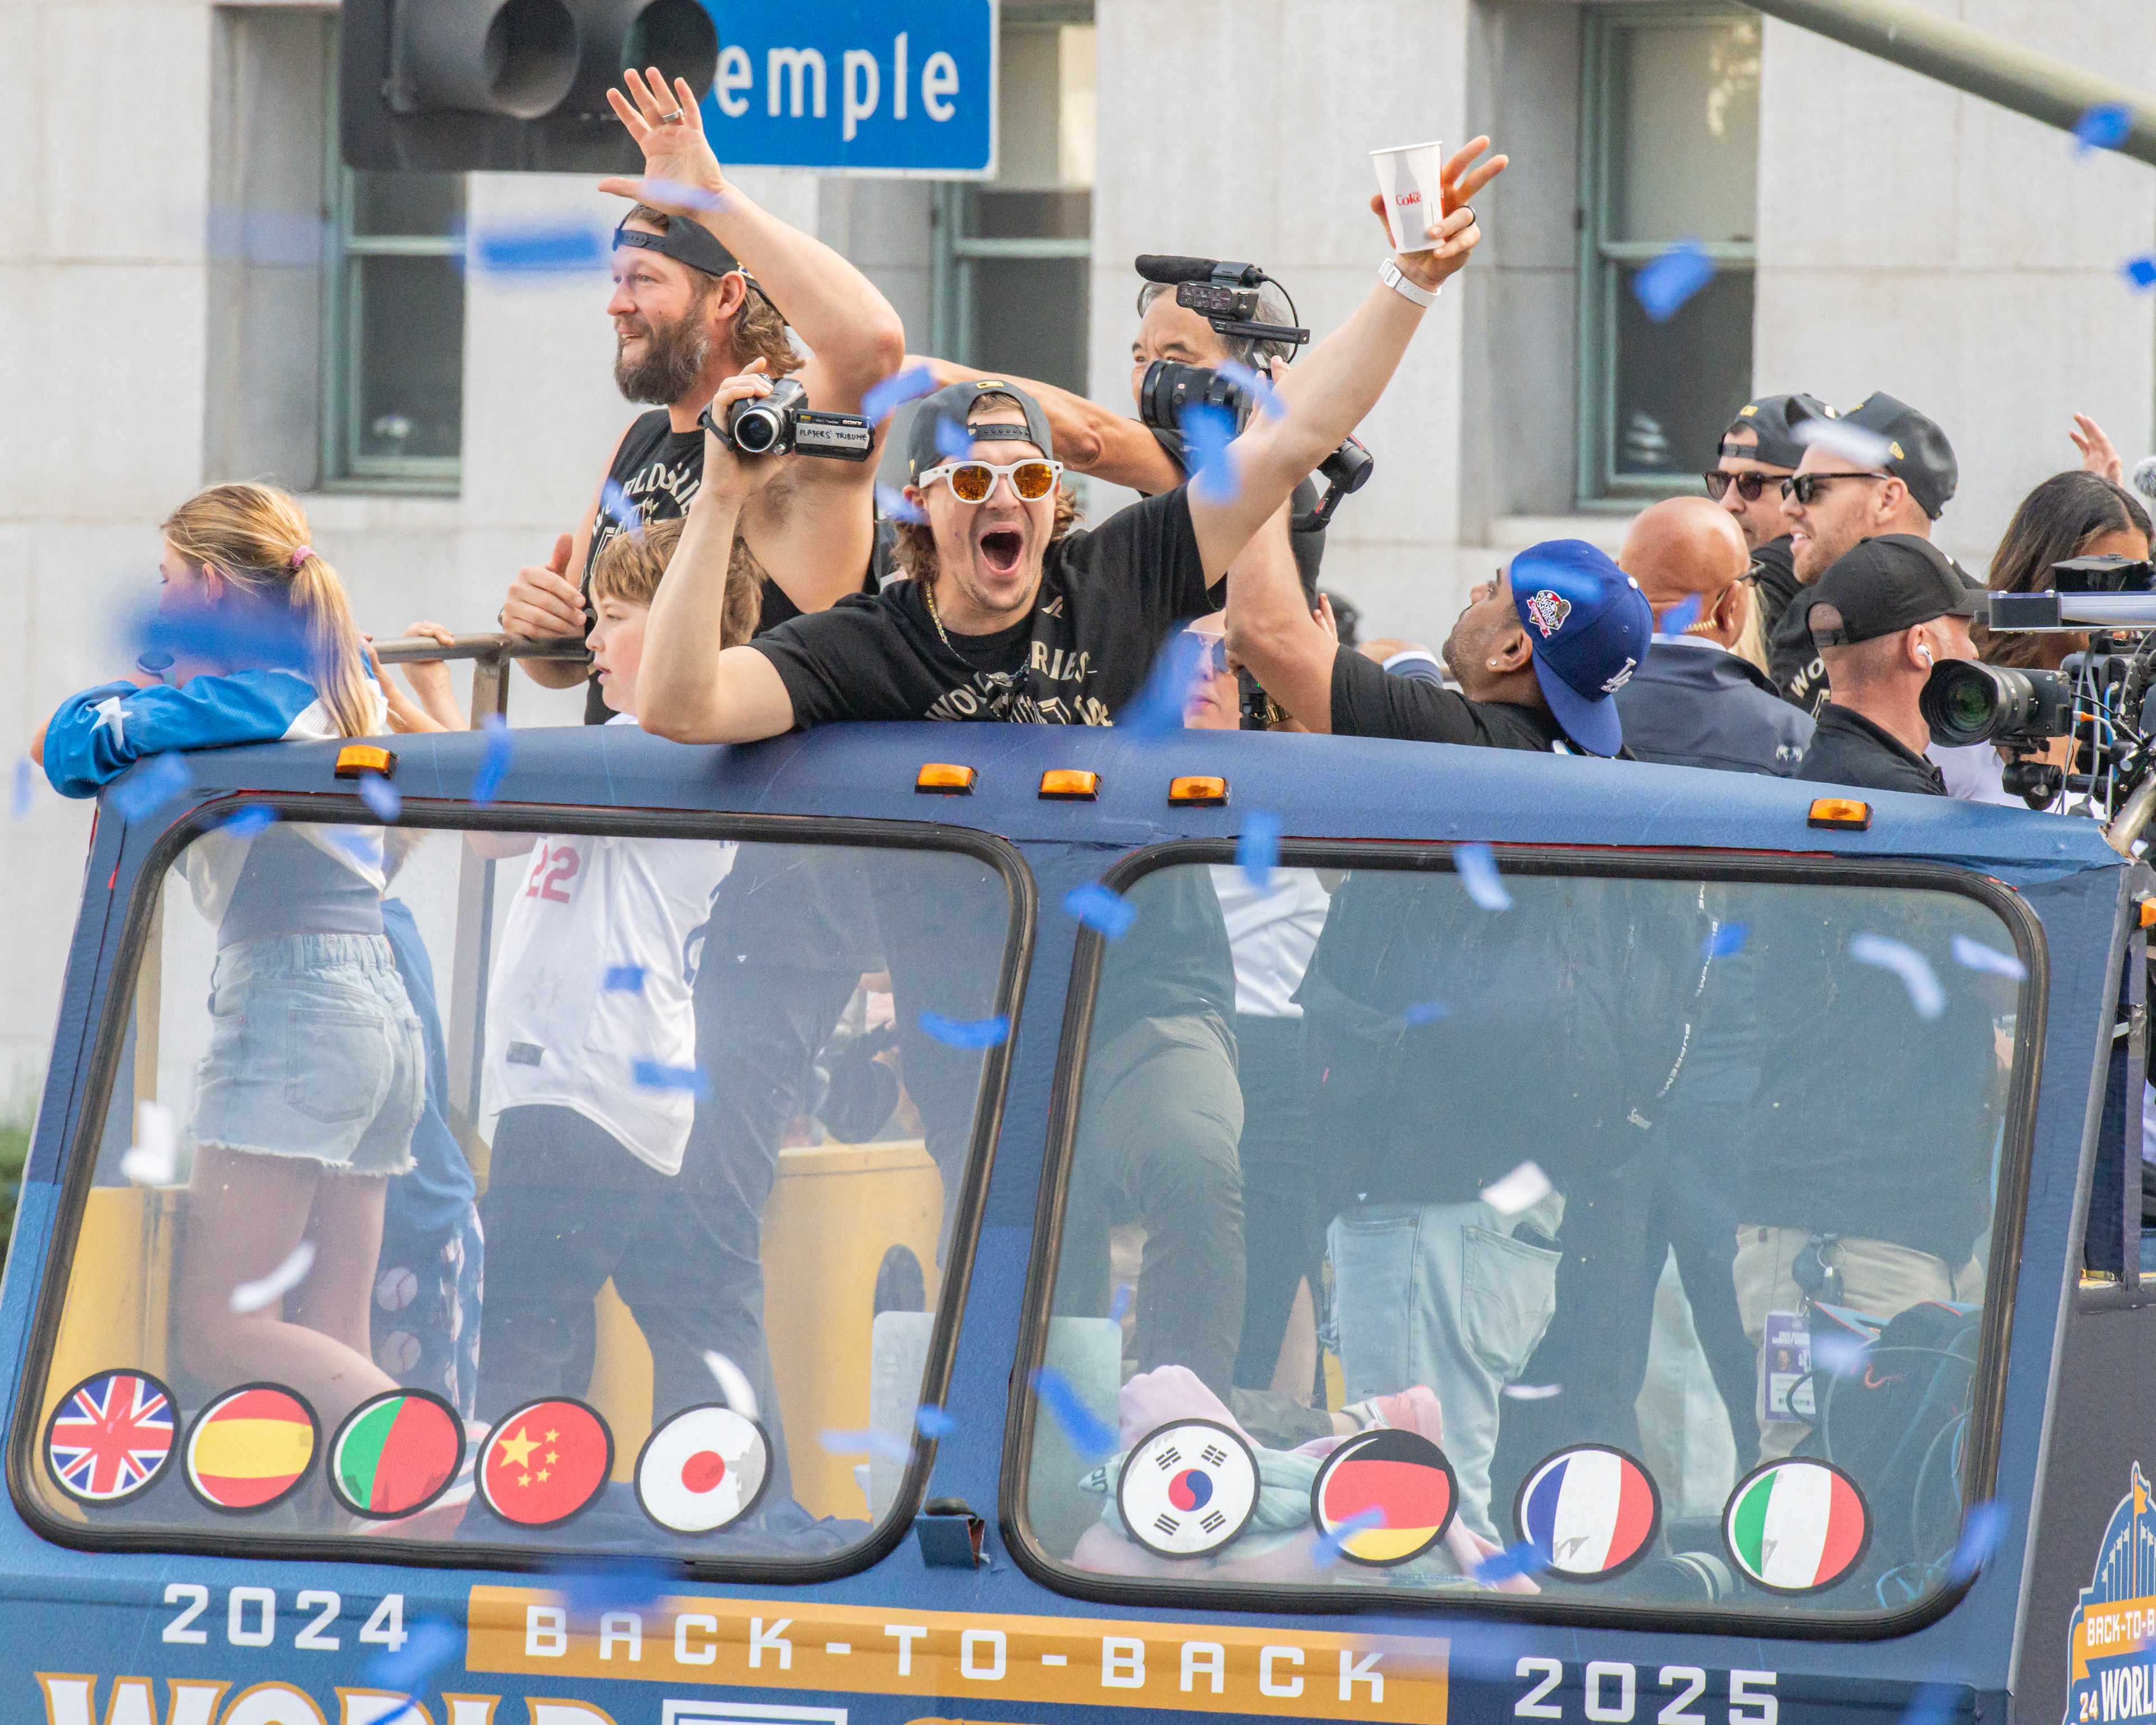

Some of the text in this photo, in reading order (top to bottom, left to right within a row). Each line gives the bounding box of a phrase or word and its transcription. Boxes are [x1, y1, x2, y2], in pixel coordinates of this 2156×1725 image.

[715, 31, 960, 142] emple
[1396, 193, 1422, 206] Coke
[800, 429, 867, 441] PLAYERS' TRIBUNE
[1536, 601, 1553, 625] SERIES
[1541, 595, 1556, 620] WORLD
[1600, 657, 1637, 693] LA
[525, 843, 581, 903] 22
[162, 1583, 408, 1652] 2024
[2087, 1608, 2156, 1646] BACK-TO-B
[524, 1605, 1385, 1703] BACK-TO-BACK
[1515, 1656, 1779, 1725] 2025
[2080, 1690, 2099, 1722] 24
[2100, 1664, 2156, 1722] WORL
